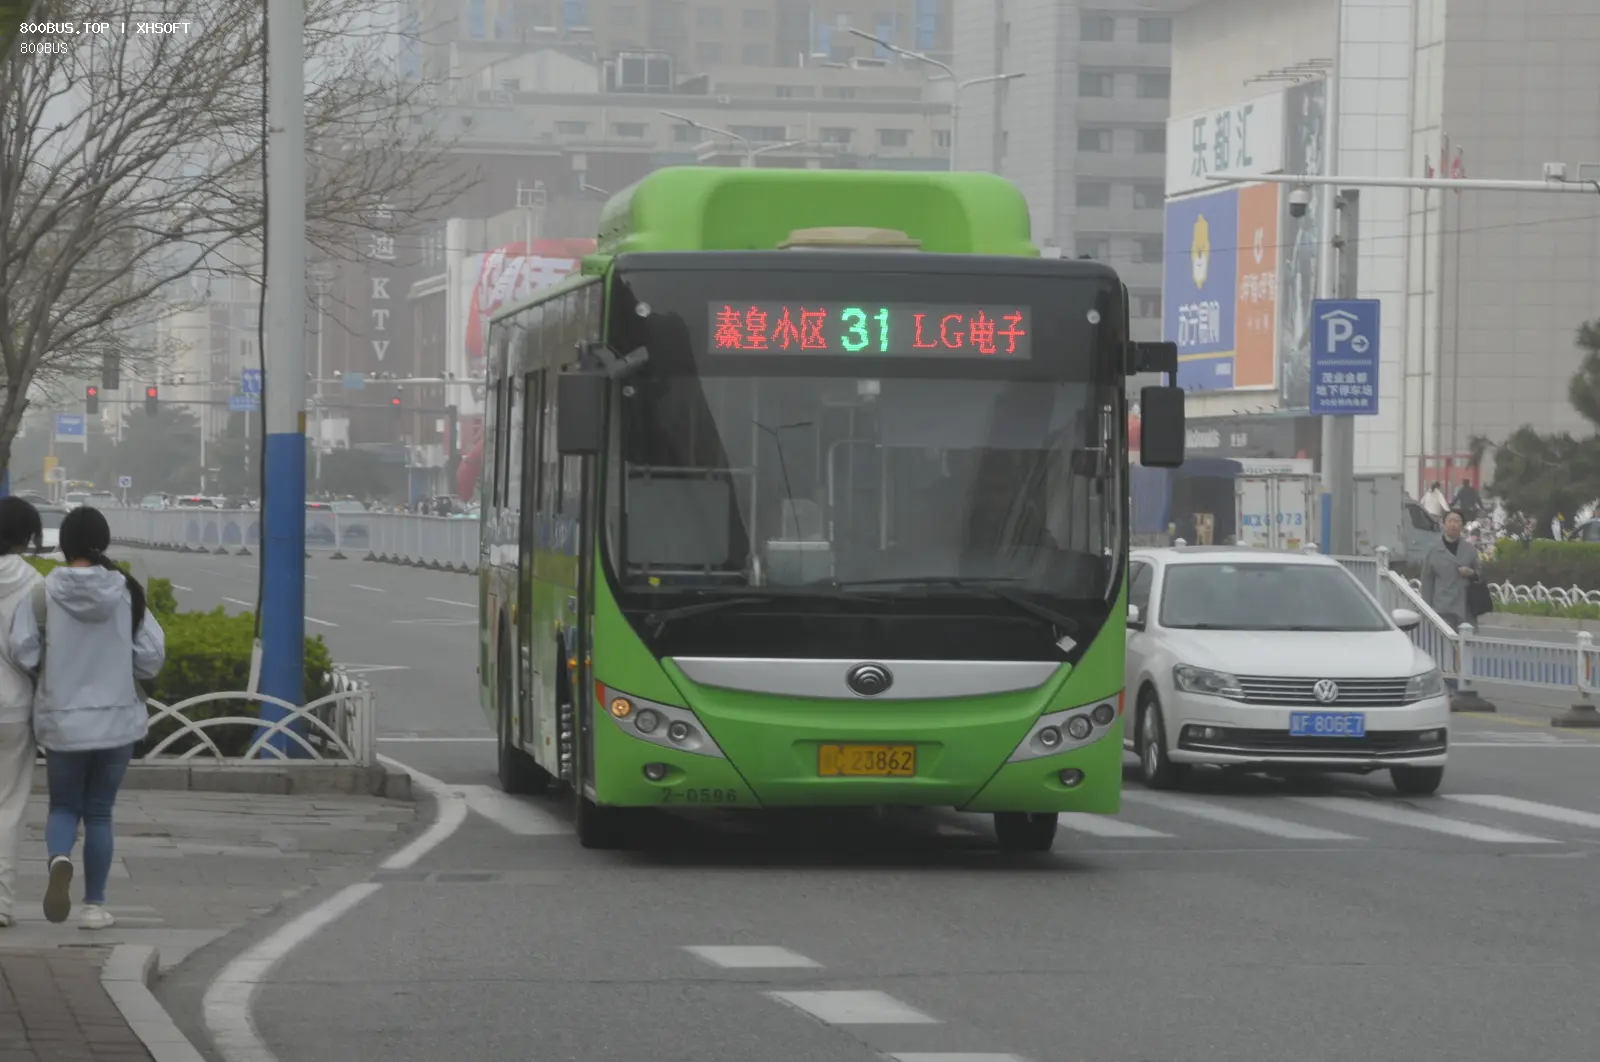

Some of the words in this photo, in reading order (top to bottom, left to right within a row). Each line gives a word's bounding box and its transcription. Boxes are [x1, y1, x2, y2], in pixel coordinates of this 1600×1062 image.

[1191, 104, 1254, 177] 乐都汇
[714, 305, 829, 349] 秦皇小区
[841, 308, 889, 352] 31
[912, 308, 1026, 354] LG电子
[1178, 300, 1219, 346] 苏宁易购
[1316, 384, 1373, 396] 地下停车场
[661, 787, 737, 803] 2-0596
